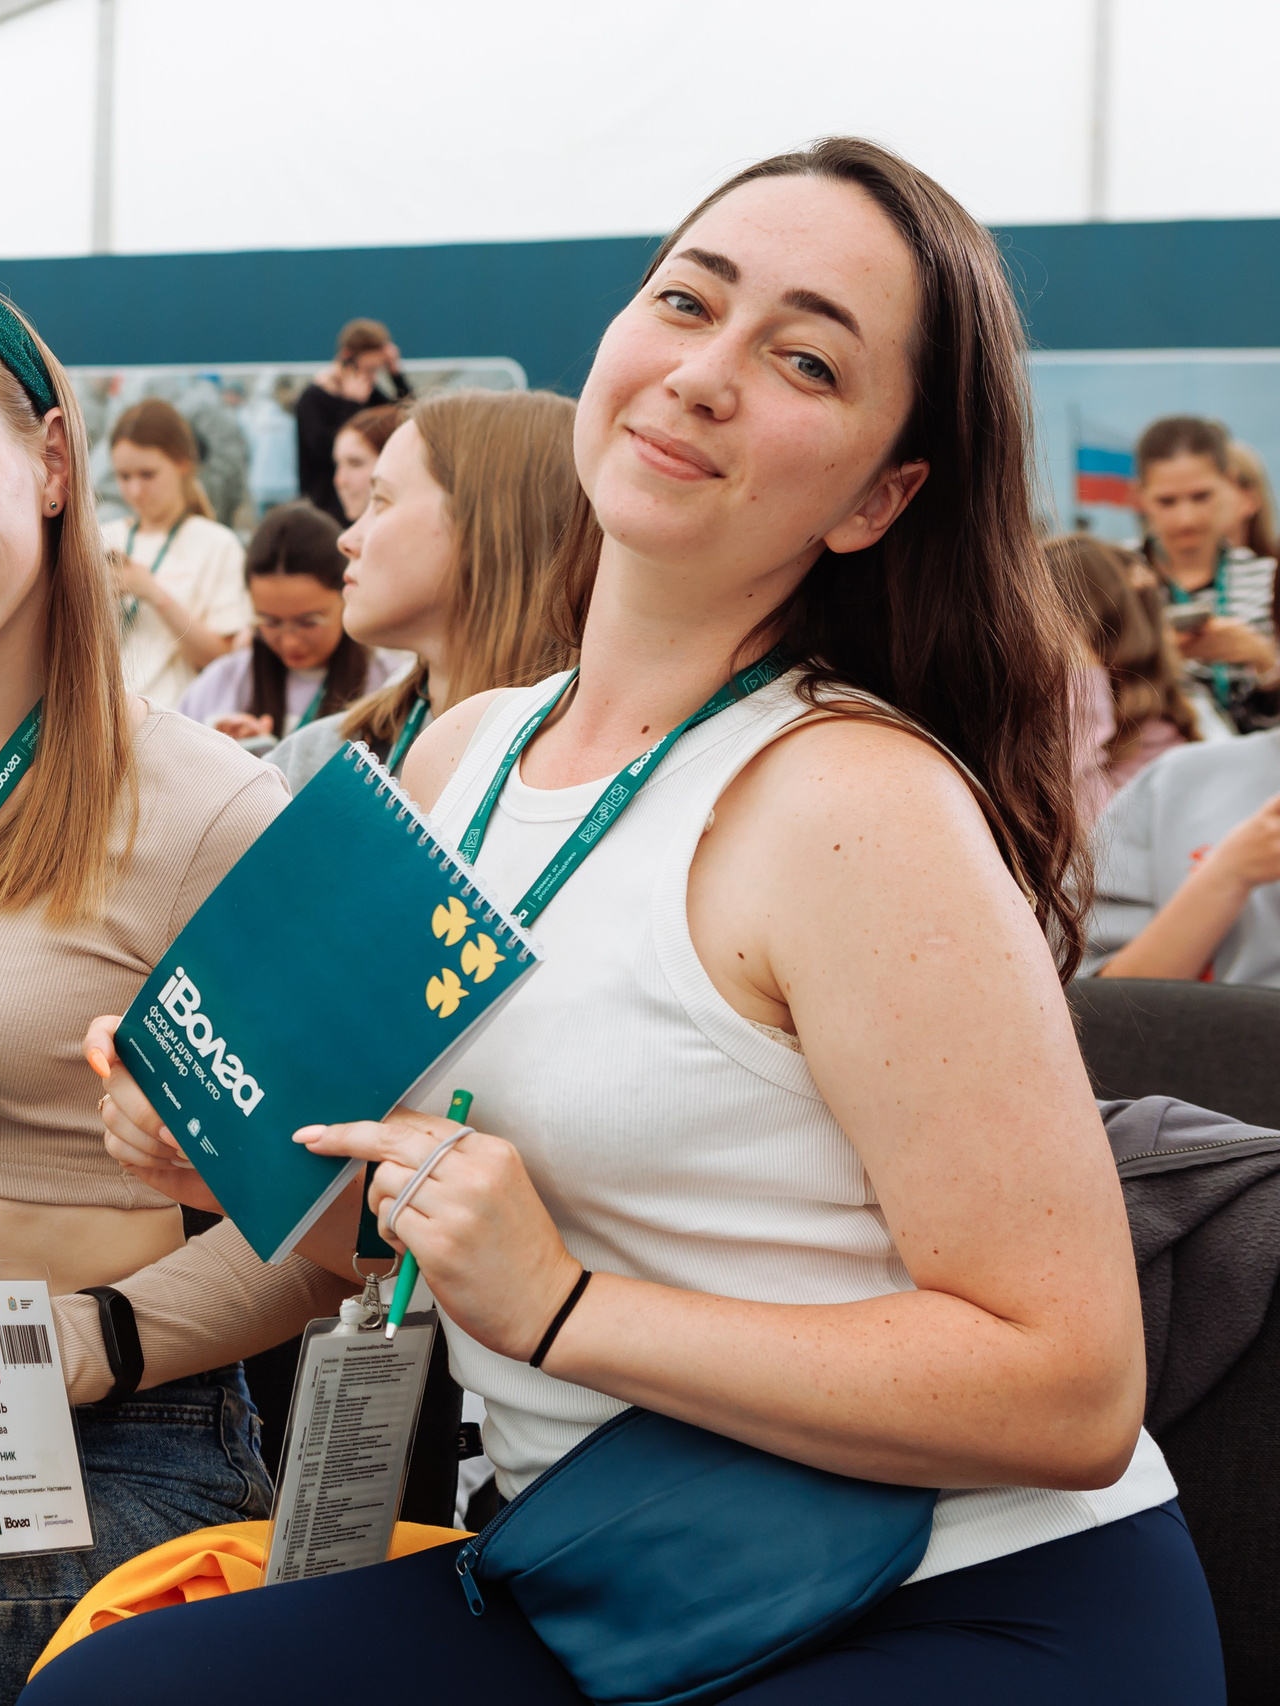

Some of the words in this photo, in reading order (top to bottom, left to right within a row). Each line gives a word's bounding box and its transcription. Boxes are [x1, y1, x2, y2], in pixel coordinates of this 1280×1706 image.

[142, 1015, 174, 1055] меняет
[169, 1052, 189, 1077] мир
[149, 1004, 178, 1046] форум
[174, 1041, 194, 1065] для
[191, 1057, 208, 1085] тех,
[205, 1079, 221, 1101] кто
[157, 966, 266, 1118] iВолга
[4, 1516, 30, 1529] iВолга
